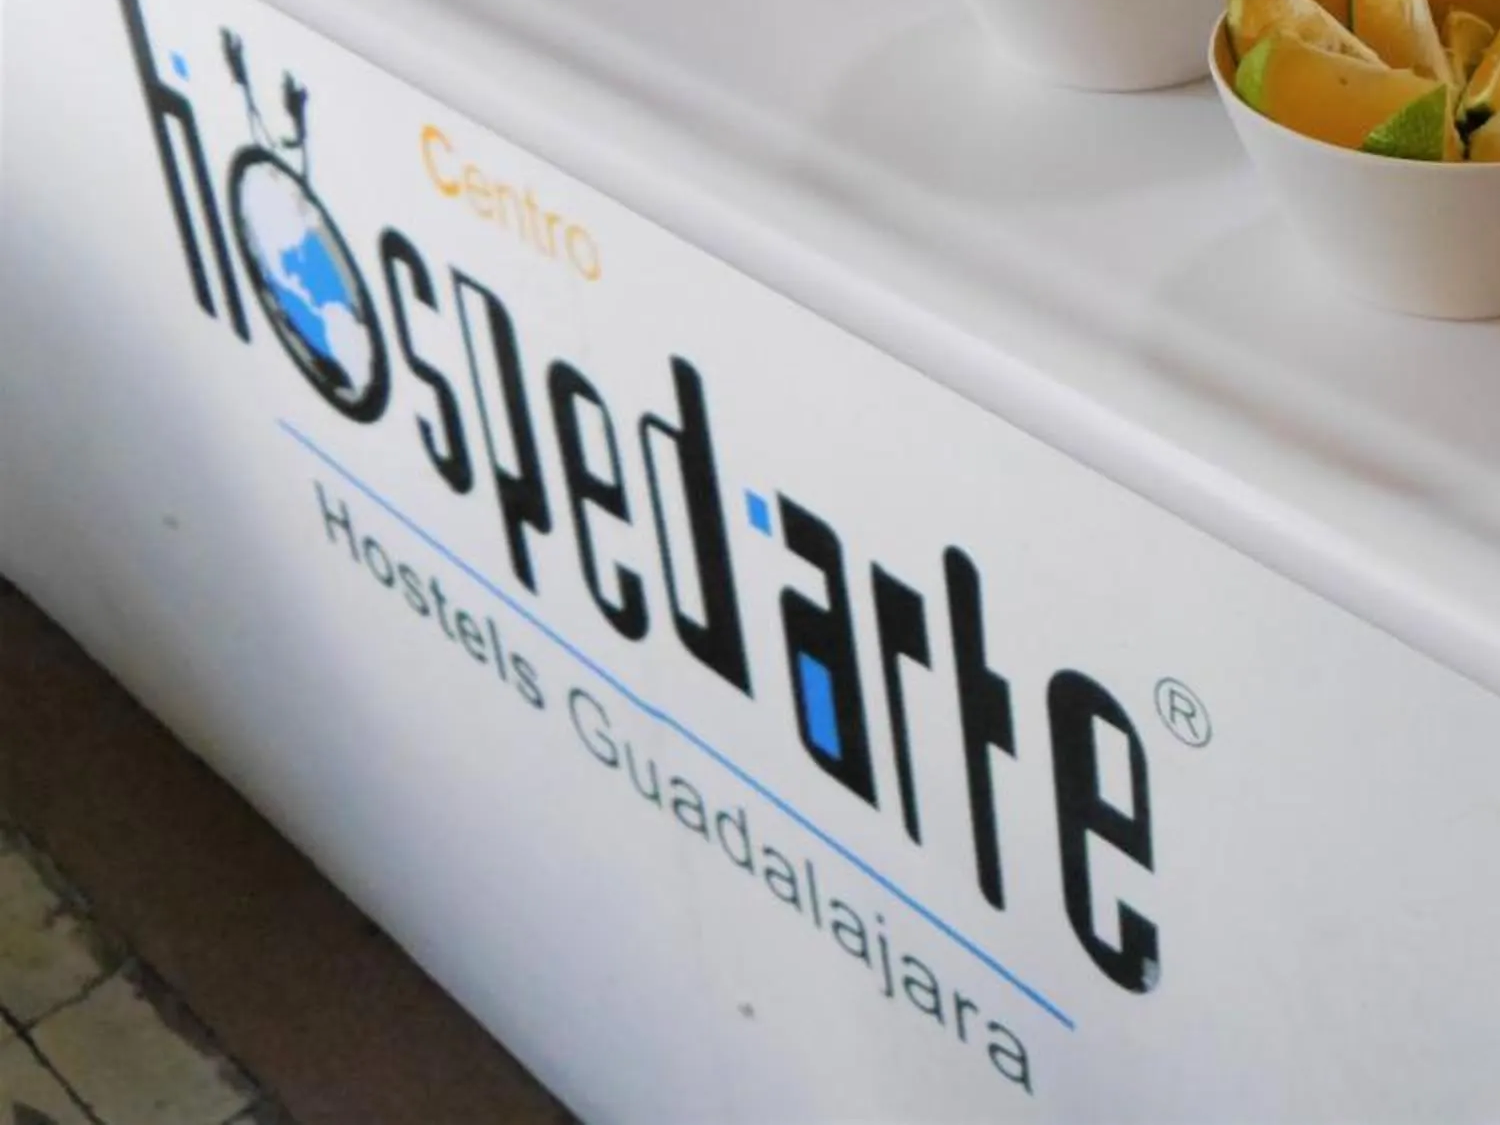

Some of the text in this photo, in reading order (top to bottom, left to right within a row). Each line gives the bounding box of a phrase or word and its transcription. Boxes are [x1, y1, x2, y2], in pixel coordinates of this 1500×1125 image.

[420, 124, 602, 282] Centro
[313, 477, 1035, 1096] Hostels Guadalajara
